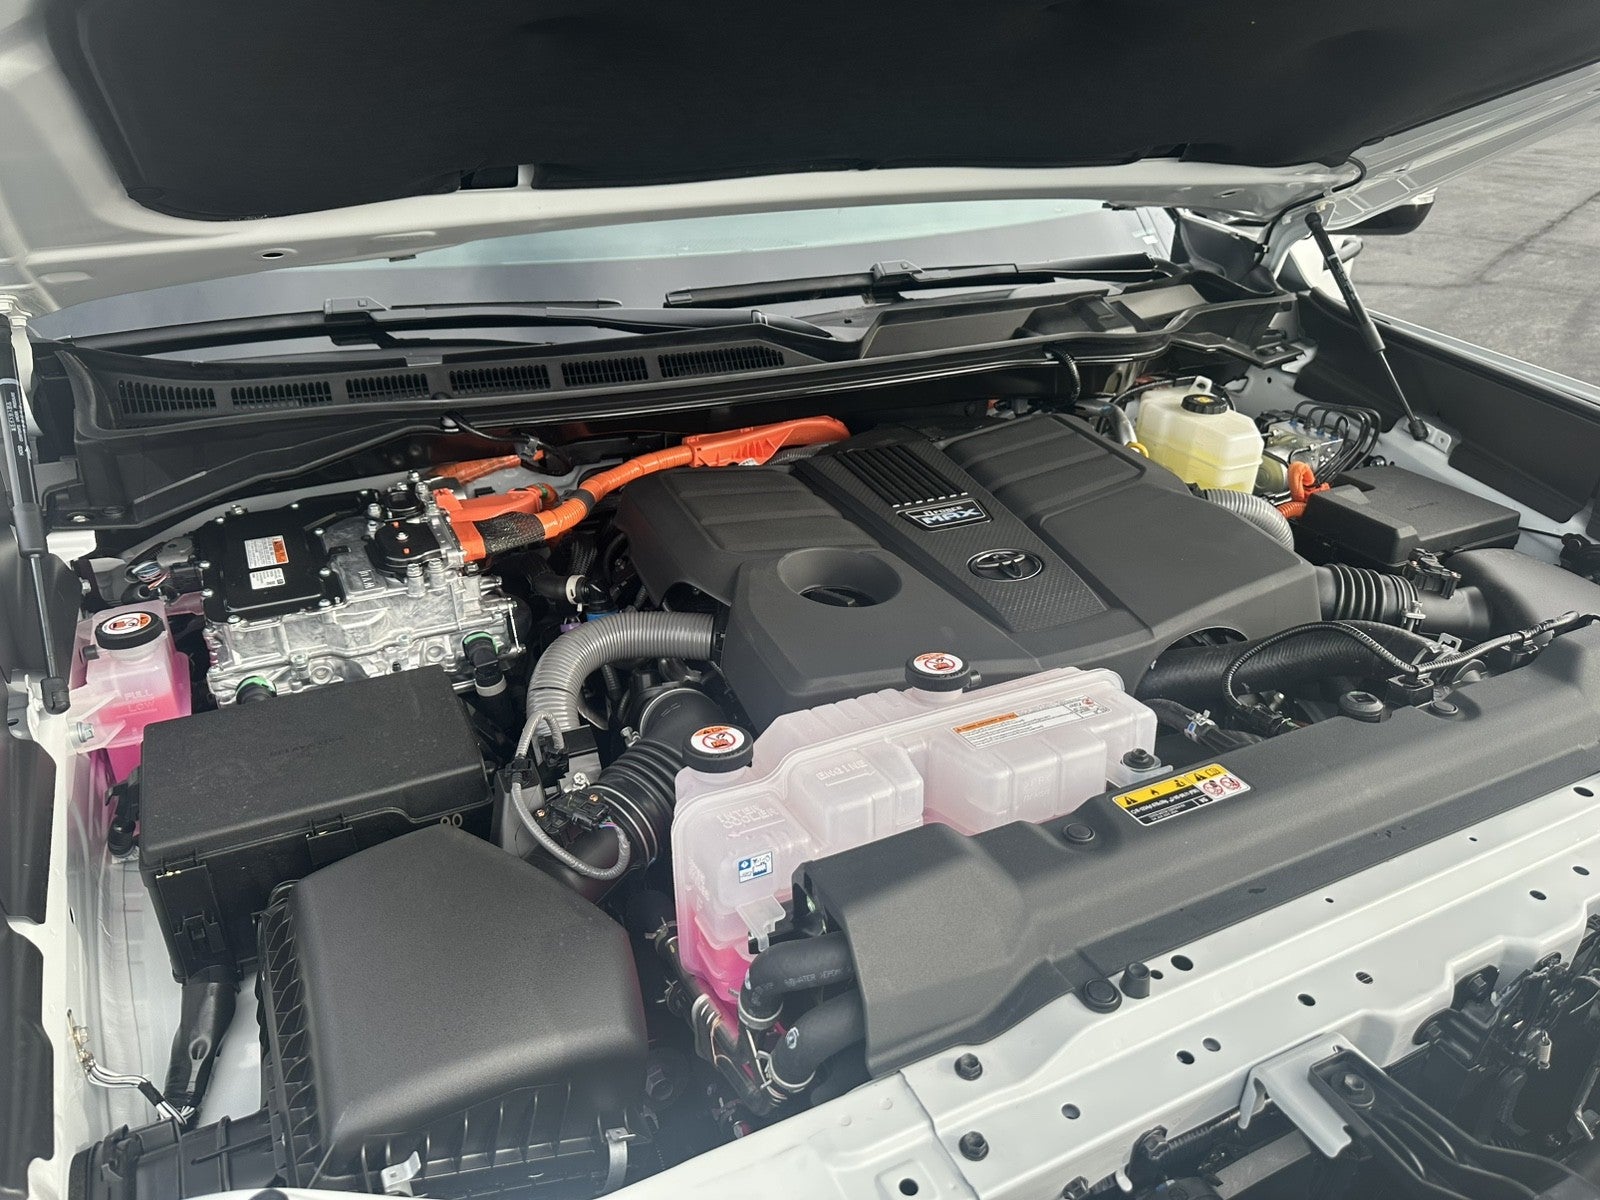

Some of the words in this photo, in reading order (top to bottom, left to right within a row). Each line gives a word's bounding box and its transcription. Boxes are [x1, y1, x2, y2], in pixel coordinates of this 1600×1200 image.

[921, 508, 981, 524] MAX
[124, 690, 153, 702] FULL
[128, 700, 155, 712] LOW
[815, 759, 868, 781] ENGINE
[716, 804, 760, 823] INTER
[722, 808, 779, 829] COOLER
